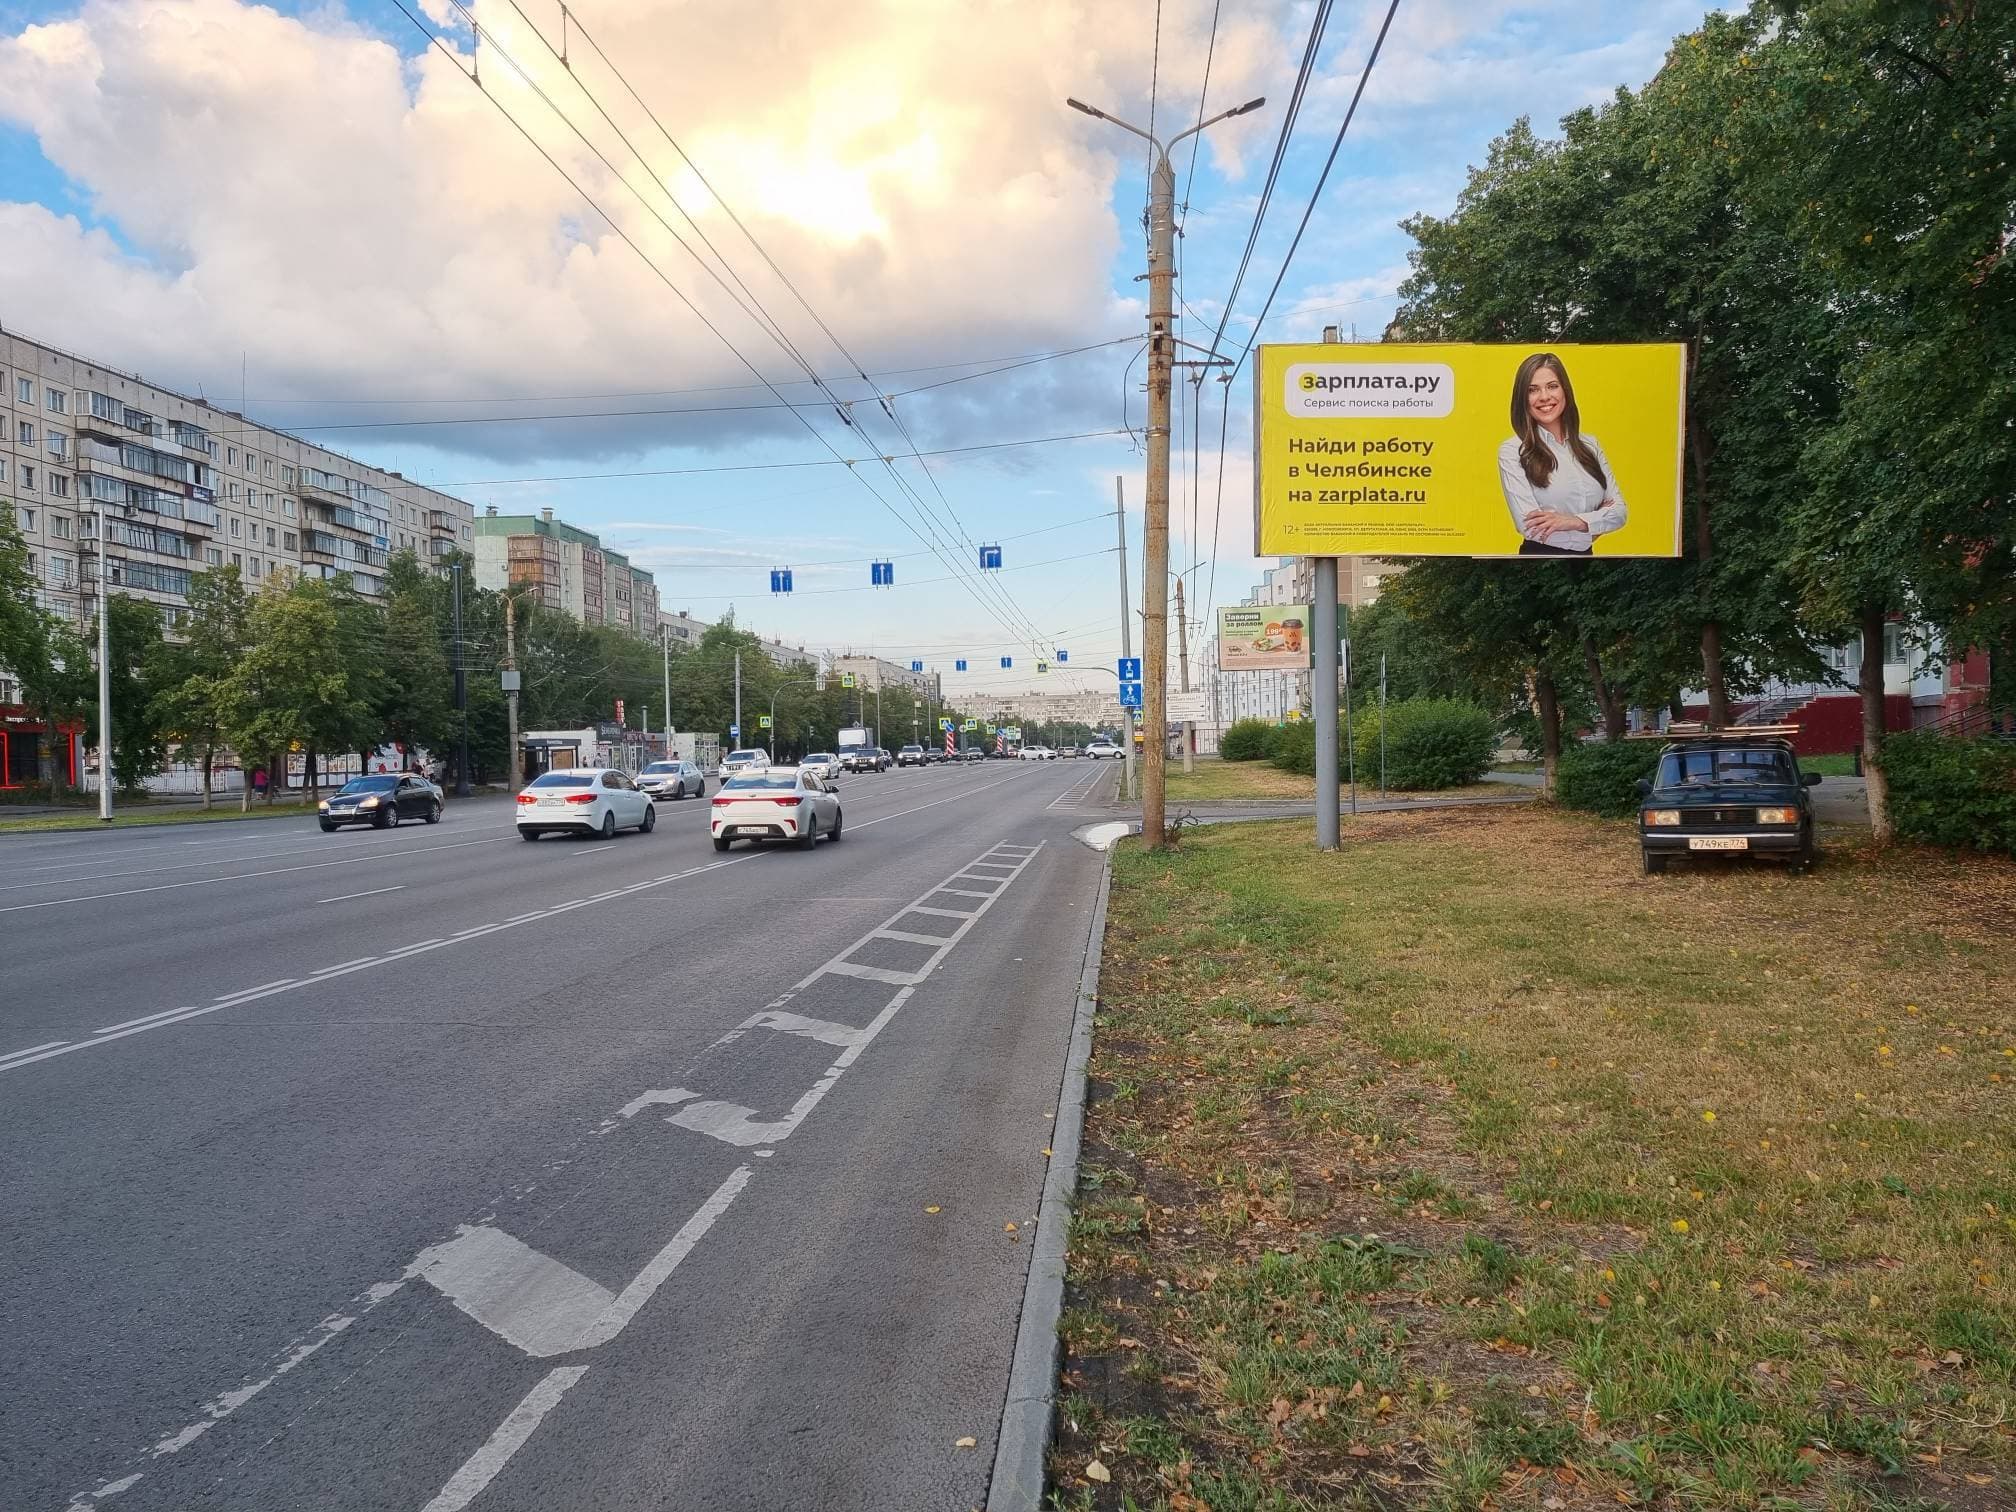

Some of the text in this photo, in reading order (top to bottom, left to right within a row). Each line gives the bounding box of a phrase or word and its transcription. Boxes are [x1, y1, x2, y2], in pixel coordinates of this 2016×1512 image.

[1303, 375, 1440, 393] зарплата.ру
[1304, 398, 1434, 409] Сервис поиска работы
[1289, 437, 1434, 457] Найди работу
[1289, 462, 1432, 478] в Челябинске
[1289, 486, 1426, 505] на zarplata.ru
[1283, 525, 1300, 536] 12+
